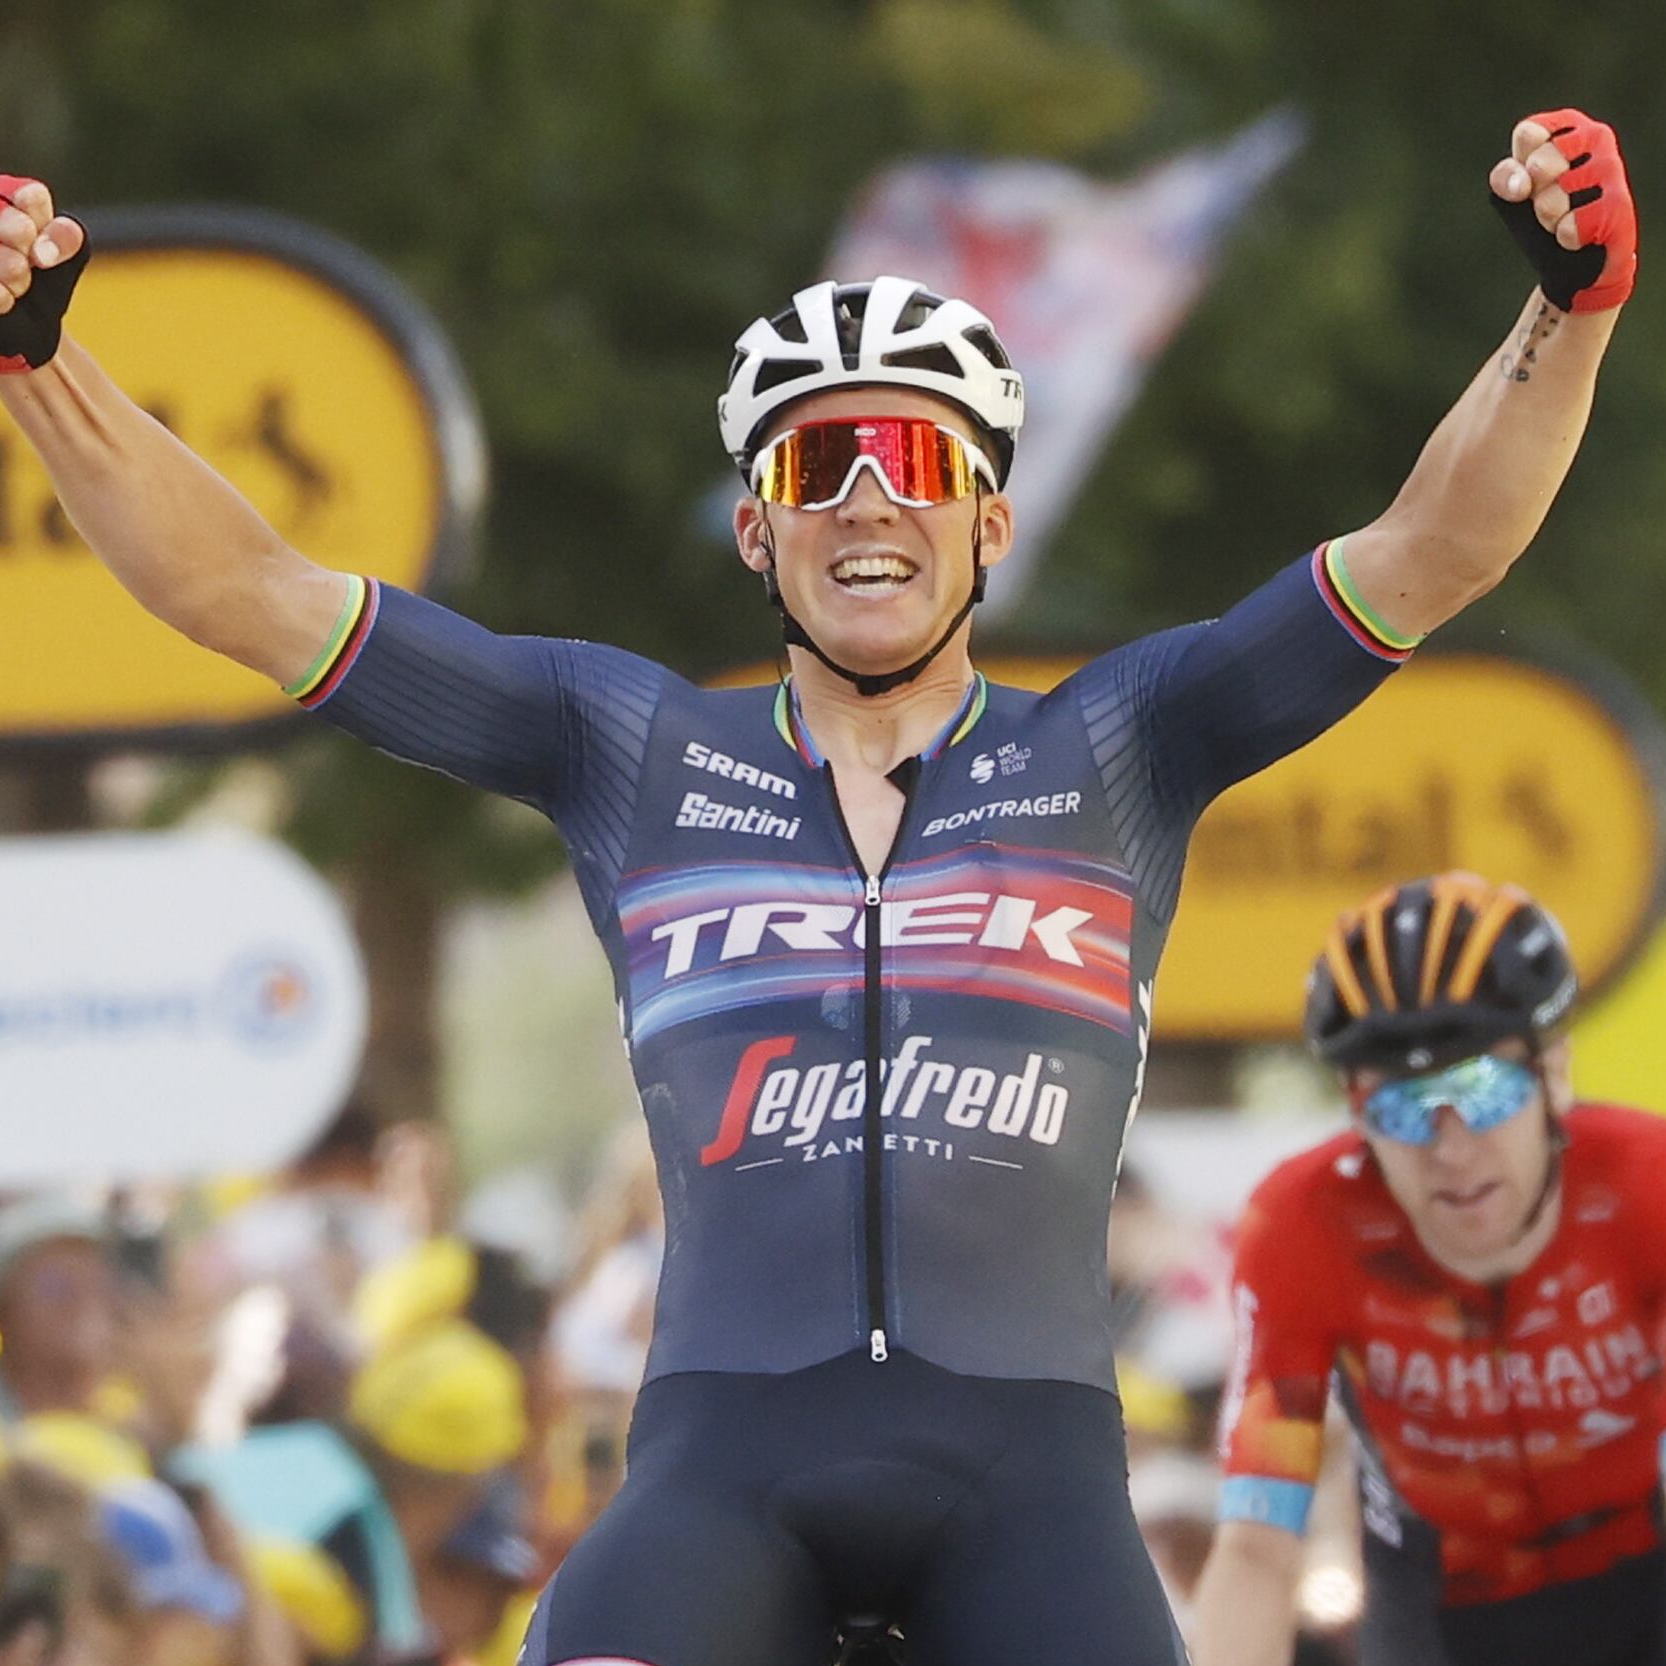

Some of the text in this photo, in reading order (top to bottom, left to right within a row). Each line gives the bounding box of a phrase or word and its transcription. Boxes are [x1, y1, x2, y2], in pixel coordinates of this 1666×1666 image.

[683, 741, 796, 799] SRAM
[997, 741, 1016, 757] UCI
[1001, 761, 1027, 776] TEAM
[675, 792, 801, 840] Santini
[922, 791, 1081, 838] BONTRAGER
[651, 892, 1094, 980] TREK
[802, 1133, 955, 1163] ZANETTI
